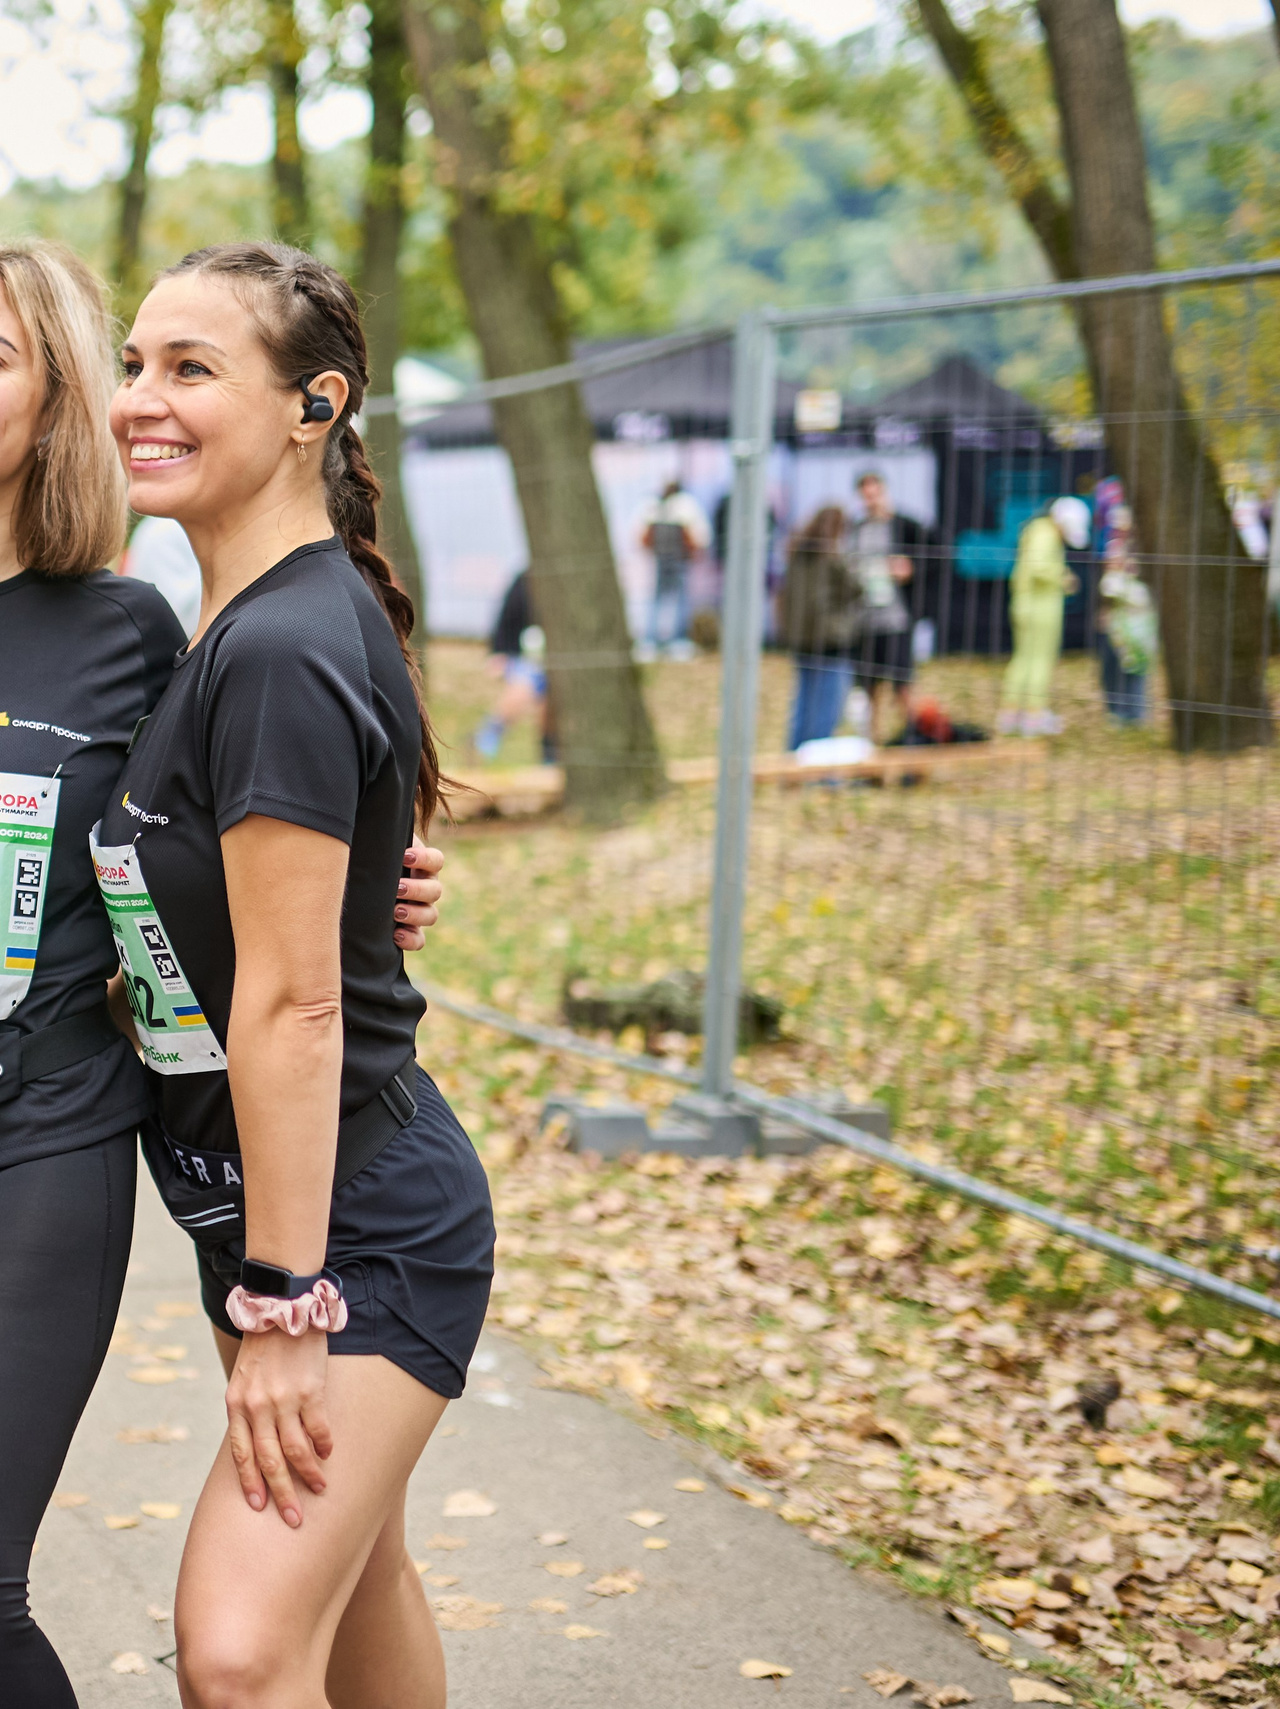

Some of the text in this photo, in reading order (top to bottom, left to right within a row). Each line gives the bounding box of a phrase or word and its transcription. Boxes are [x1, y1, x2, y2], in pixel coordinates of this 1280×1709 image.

[12, 718, 92, 743] смарт простір
[24, 830, 48, 841] 2024
[96, 864, 128, 879] ВРОРА
[130, 899, 149, 907] 2024
